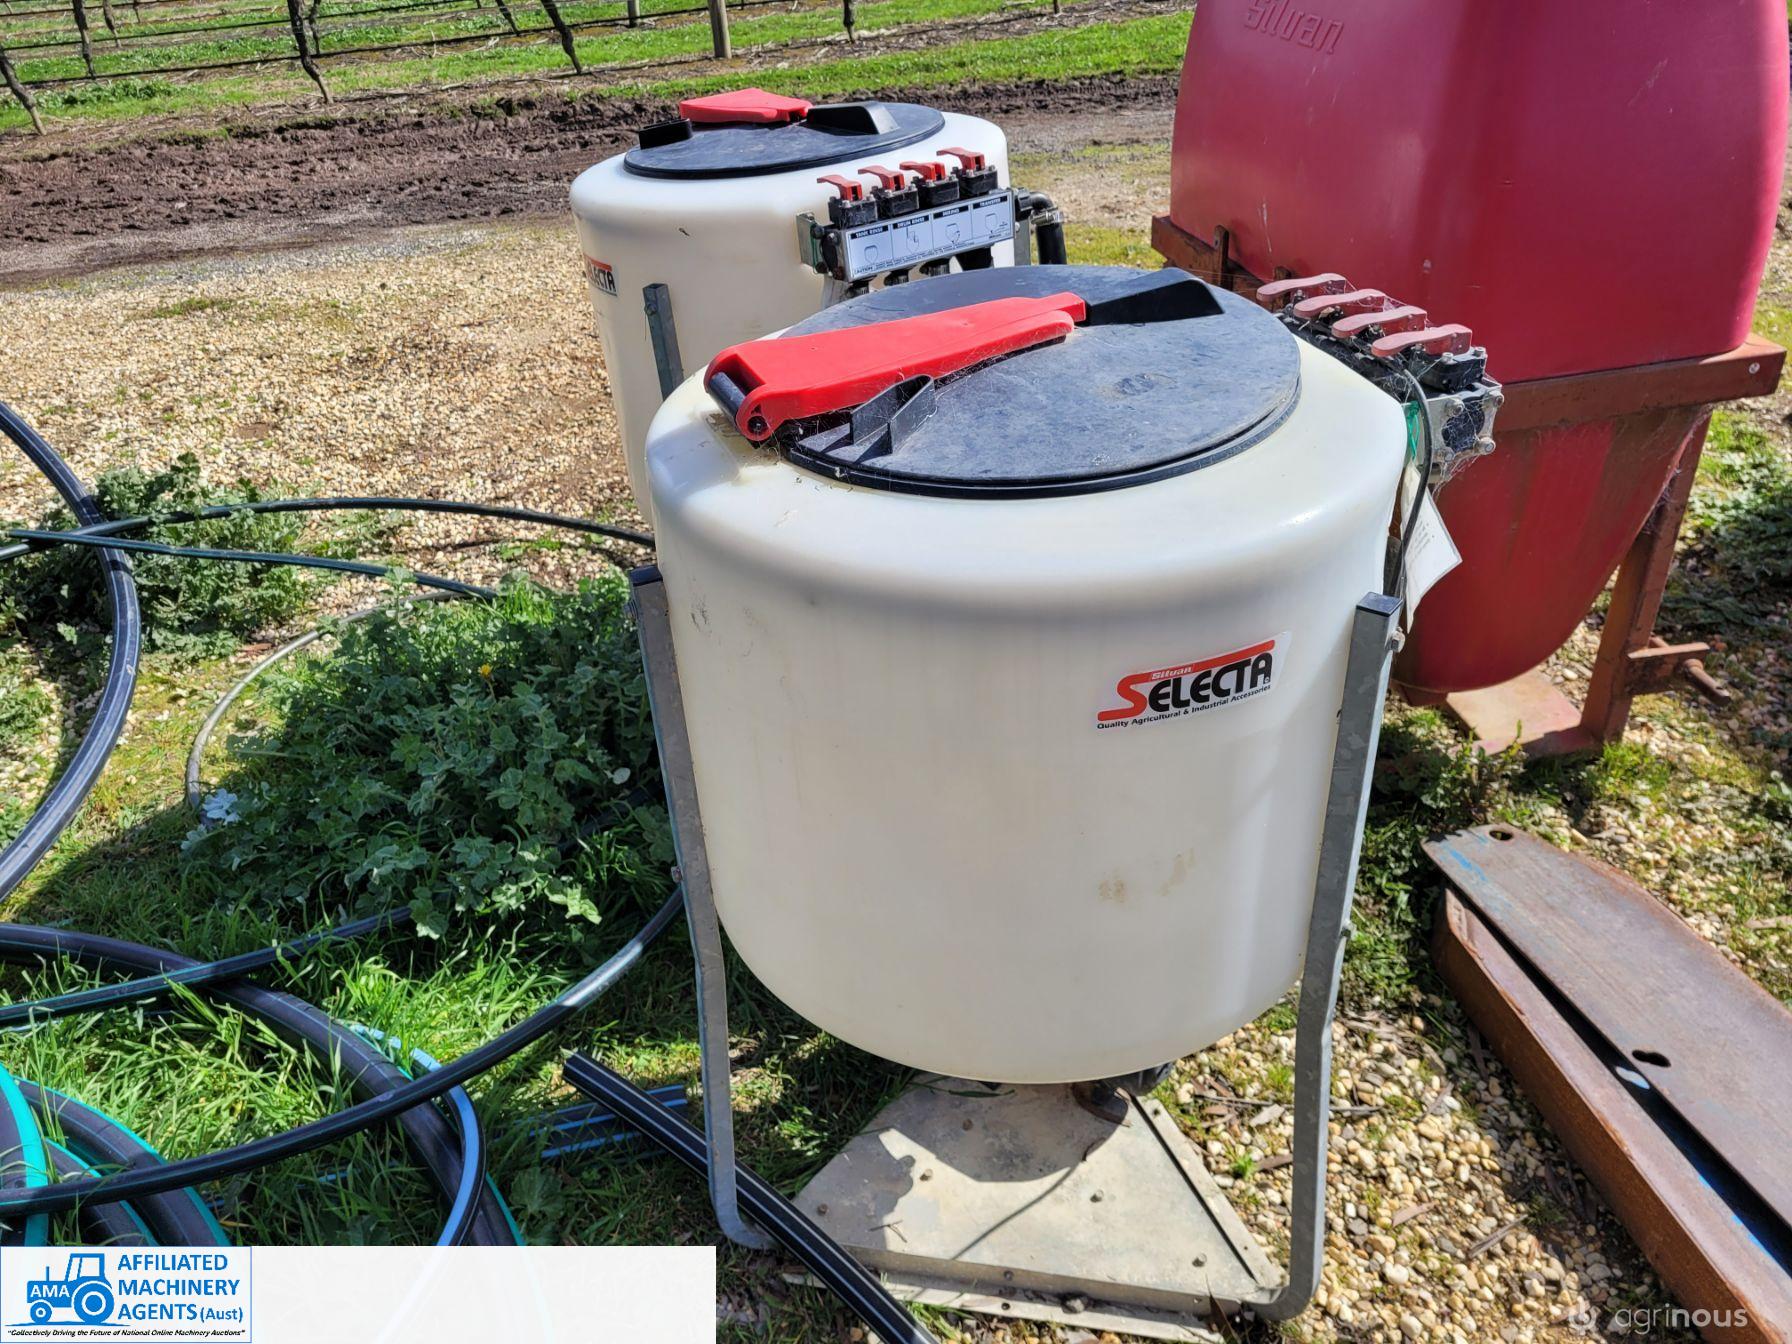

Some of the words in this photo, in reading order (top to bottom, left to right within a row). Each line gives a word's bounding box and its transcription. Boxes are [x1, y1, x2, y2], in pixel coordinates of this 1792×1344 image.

[1097, 639, 1276, 722] SELECTA
[1097, 720, 1129, 730] Quality
[1131, 710, 1181, 726] Agricultural
[1192, 697, 1229, 713] Industrial
[1231, 684, 1271, 703] Accessories
